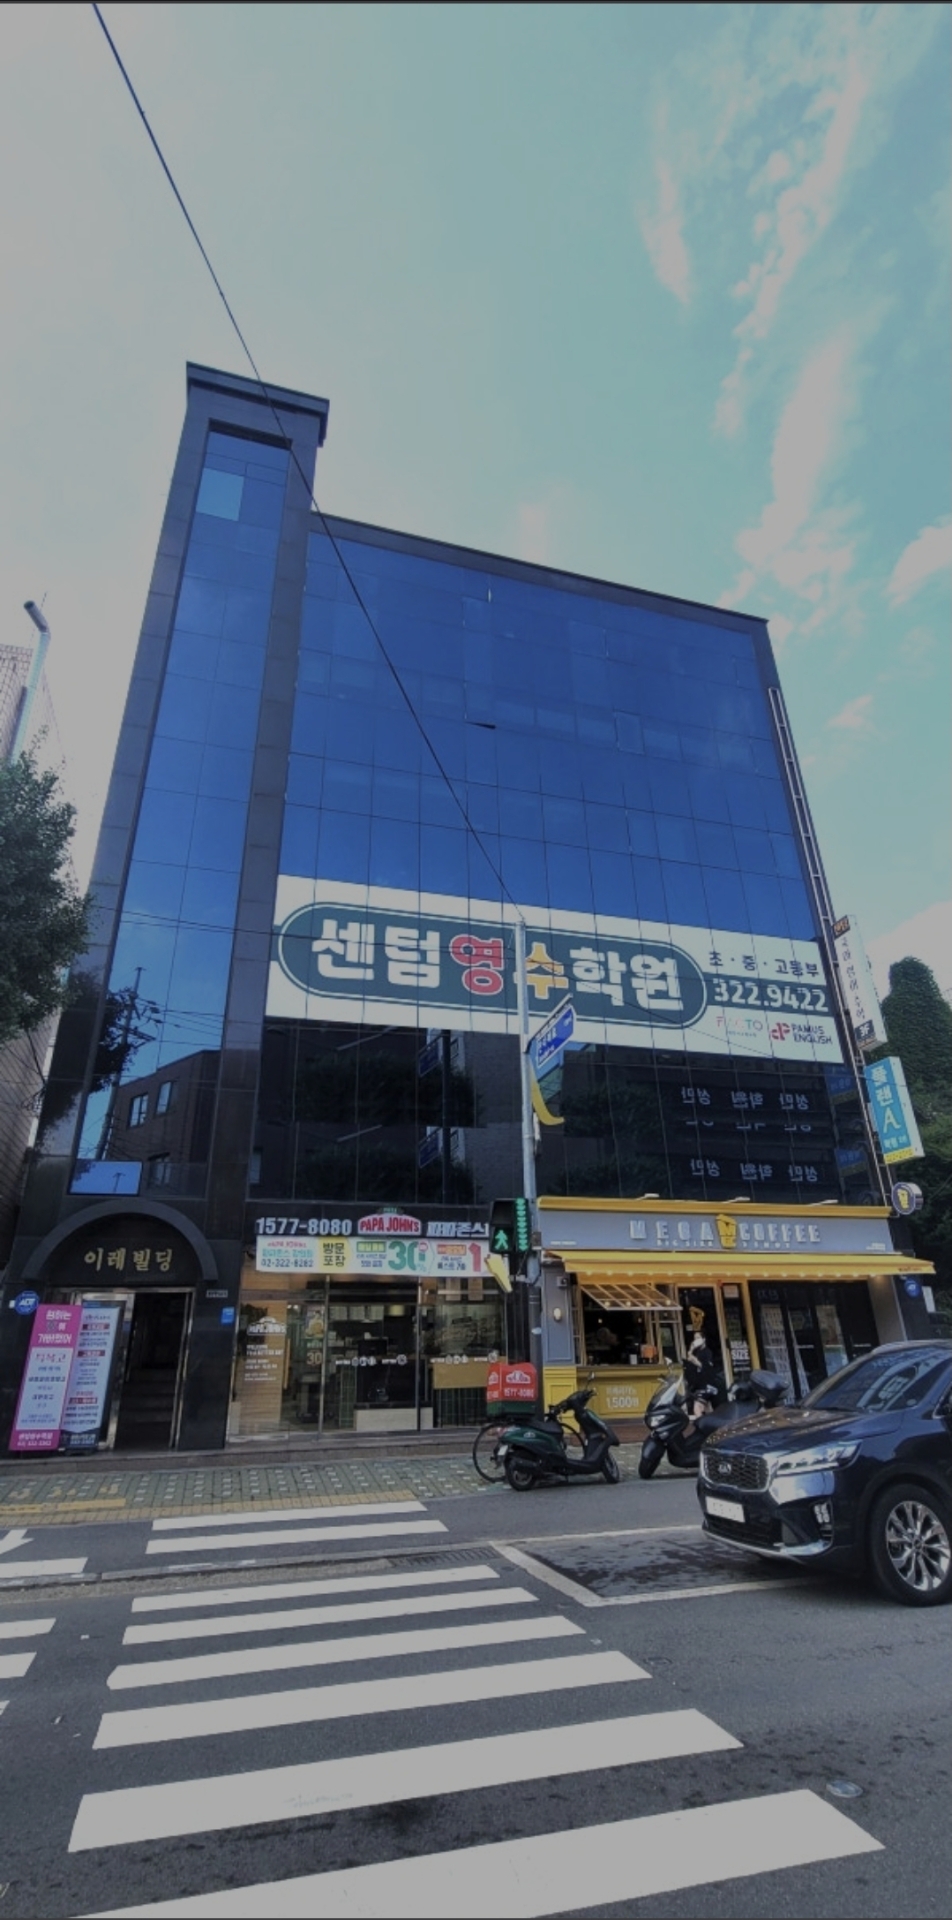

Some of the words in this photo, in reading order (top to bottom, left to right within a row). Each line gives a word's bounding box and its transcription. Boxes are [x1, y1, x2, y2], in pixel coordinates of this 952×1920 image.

[311, 918, 684, 1011] 센텀영수학원
[714, 978, 829, 1012] 322.9422
[792, 1023, 824, 1035] PAMUS
[794, 1033, 833, 1045] ENGLISH
[256, 1217, 352, 1236] 1577-8080
[360, 1217, 384, 1232] PAPA
[387, 1217, 420, 1233] JOHN'S
[427, 1221, 490, 1237] 파파존스
[629, 1220, 714, 1241] MEGA
[739, 1222, 821, 1243] COFFEE
[323, 1243, 345, 1255] 방문
[84, 1247, 174, 1272] 이레빌딩
[323, 1256, 346, 1268] 포장
[731, 1349, 750, 1360] SIZE
